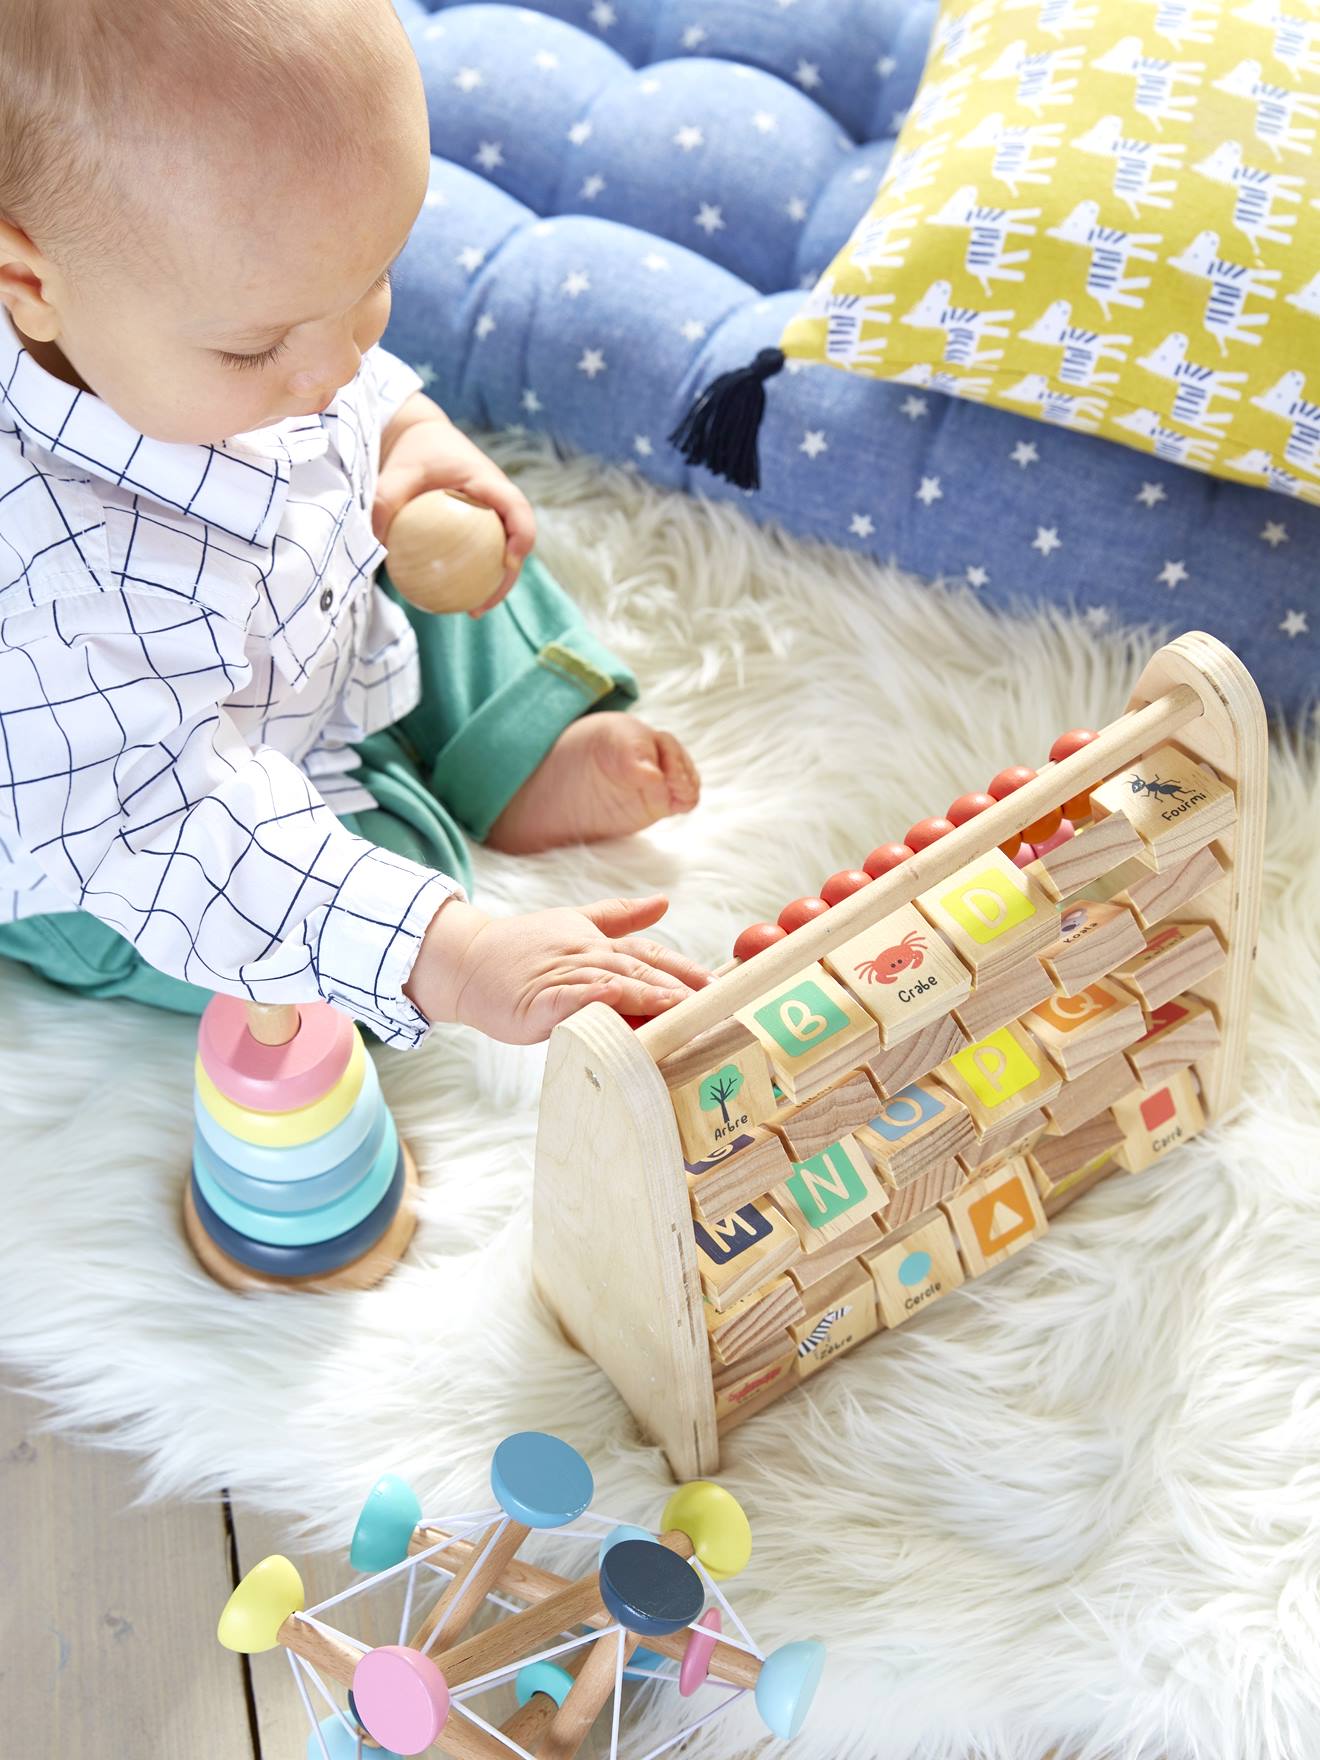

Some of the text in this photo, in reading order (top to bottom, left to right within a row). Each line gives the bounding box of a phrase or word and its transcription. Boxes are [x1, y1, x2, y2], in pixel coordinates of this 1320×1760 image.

[1161, 792, 1207, 822] Fourmi
[962, 888, 1007, 929] D
[898, 976, 938, 1003] Crabe
[1051, 991, 1103, 1019] Q
[779, 1000, 828, 1041] B
[973, 1046, 1007, 1095] P
[880, 1097, 923, 1126] O
[714, 1114, 749, 1141] Arbre
[800, 1153, 850, 1214] N
[706, 1212, 758, 1253] M
[904, 1281, 942, 1310] Cercle
